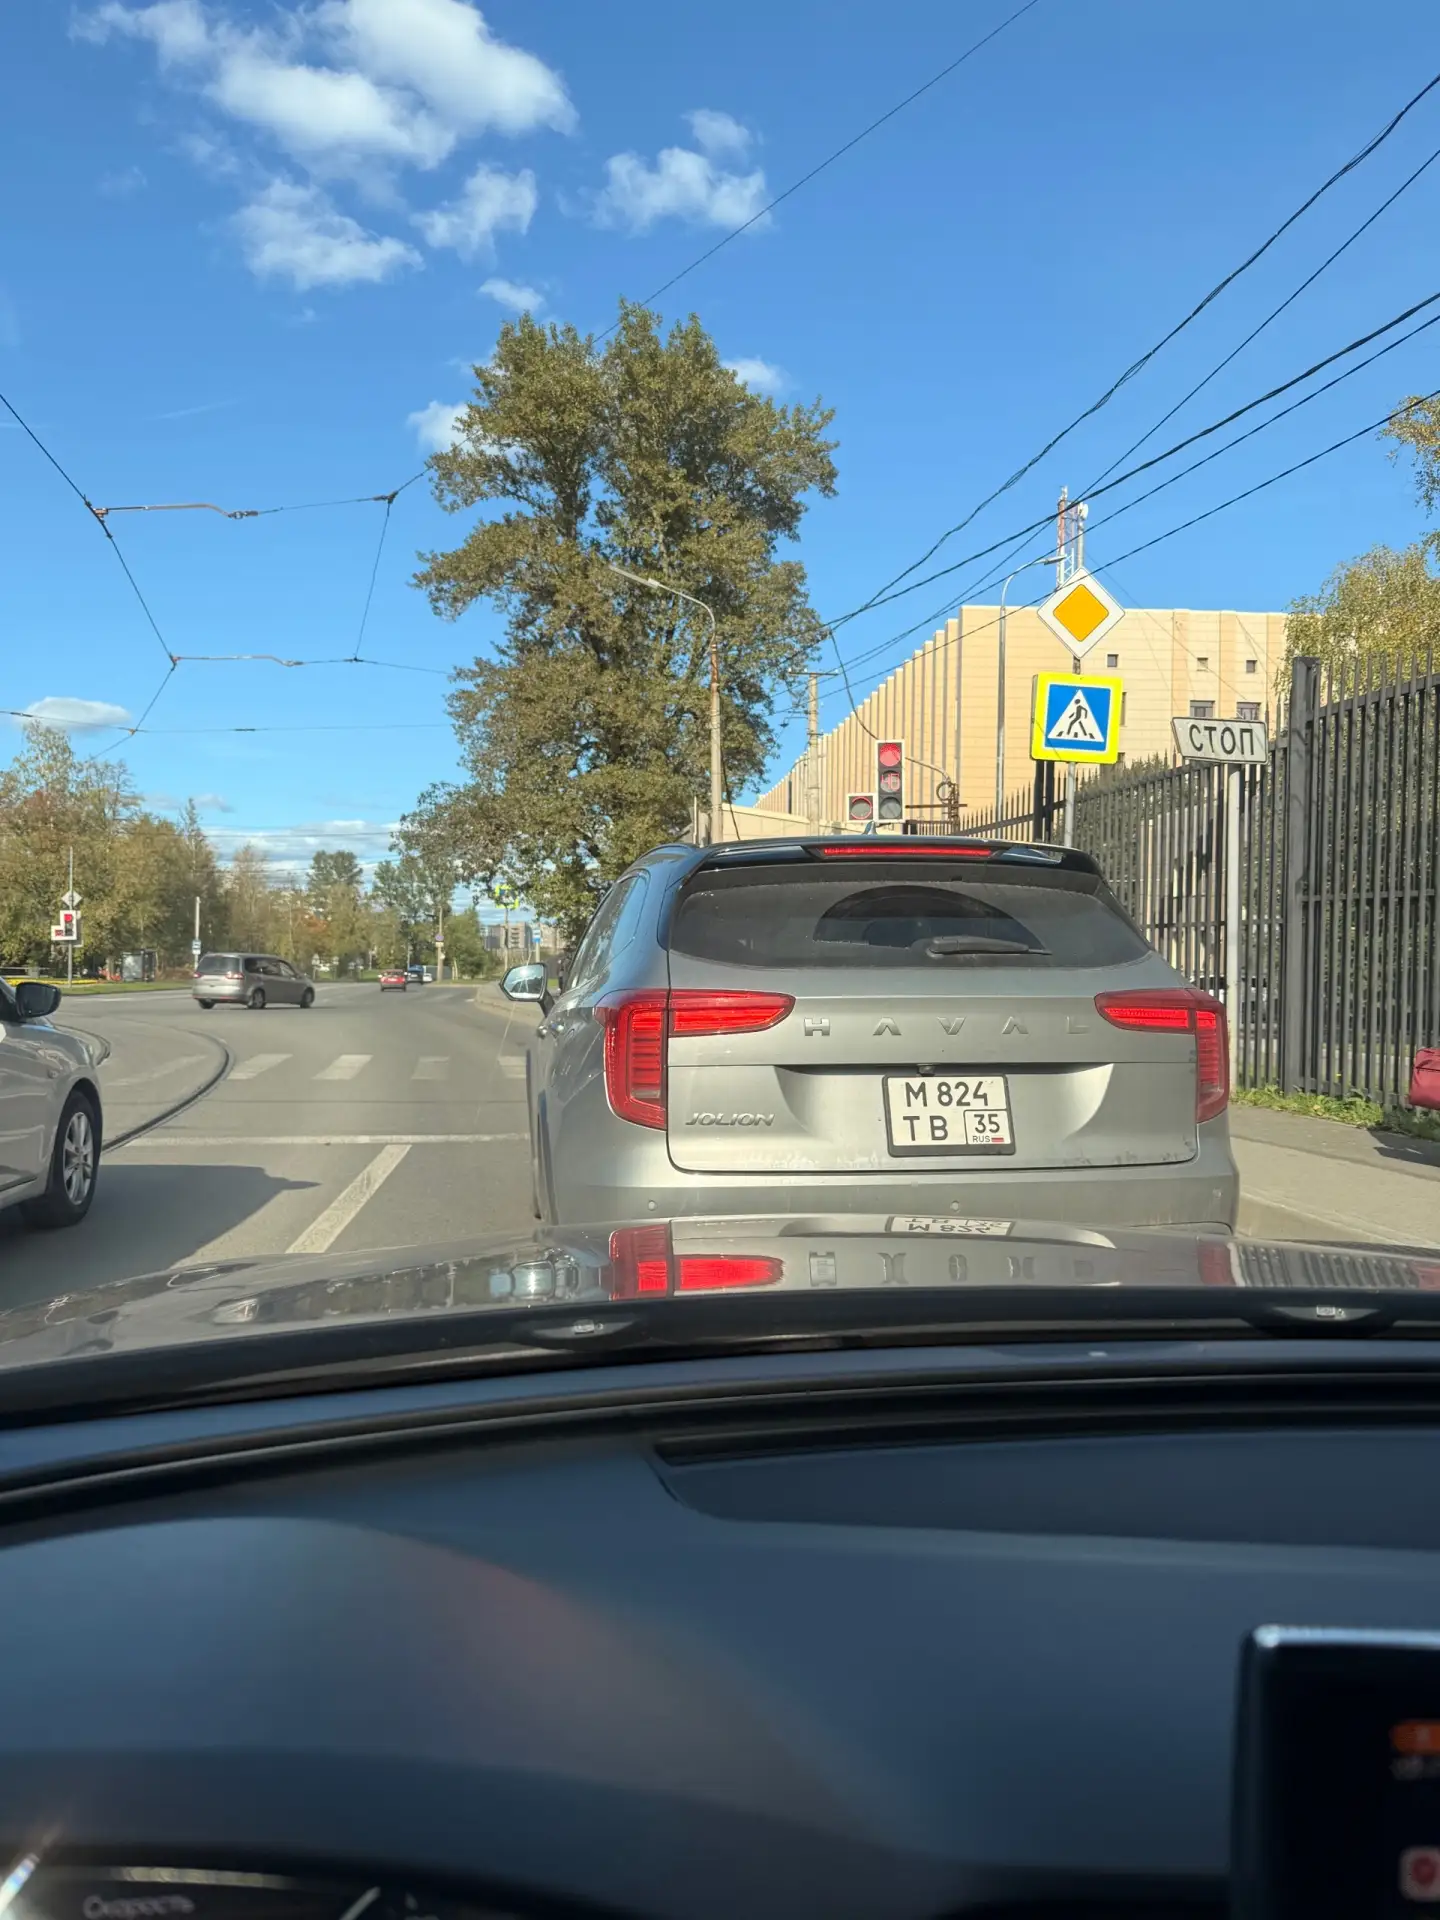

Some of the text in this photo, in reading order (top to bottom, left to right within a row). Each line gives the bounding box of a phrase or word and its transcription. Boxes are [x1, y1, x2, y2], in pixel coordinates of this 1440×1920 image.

[1188, 723, 1254, 756] СТОП
[804, 1016, 1091, 1037] HAVAL
[937, 1081, 988, 1106] 824
[685, 1112, 775, 1126] JOLION
[973, 1113, 1000, 1133] 35
[972, 1135, 991, 1143] RUS
